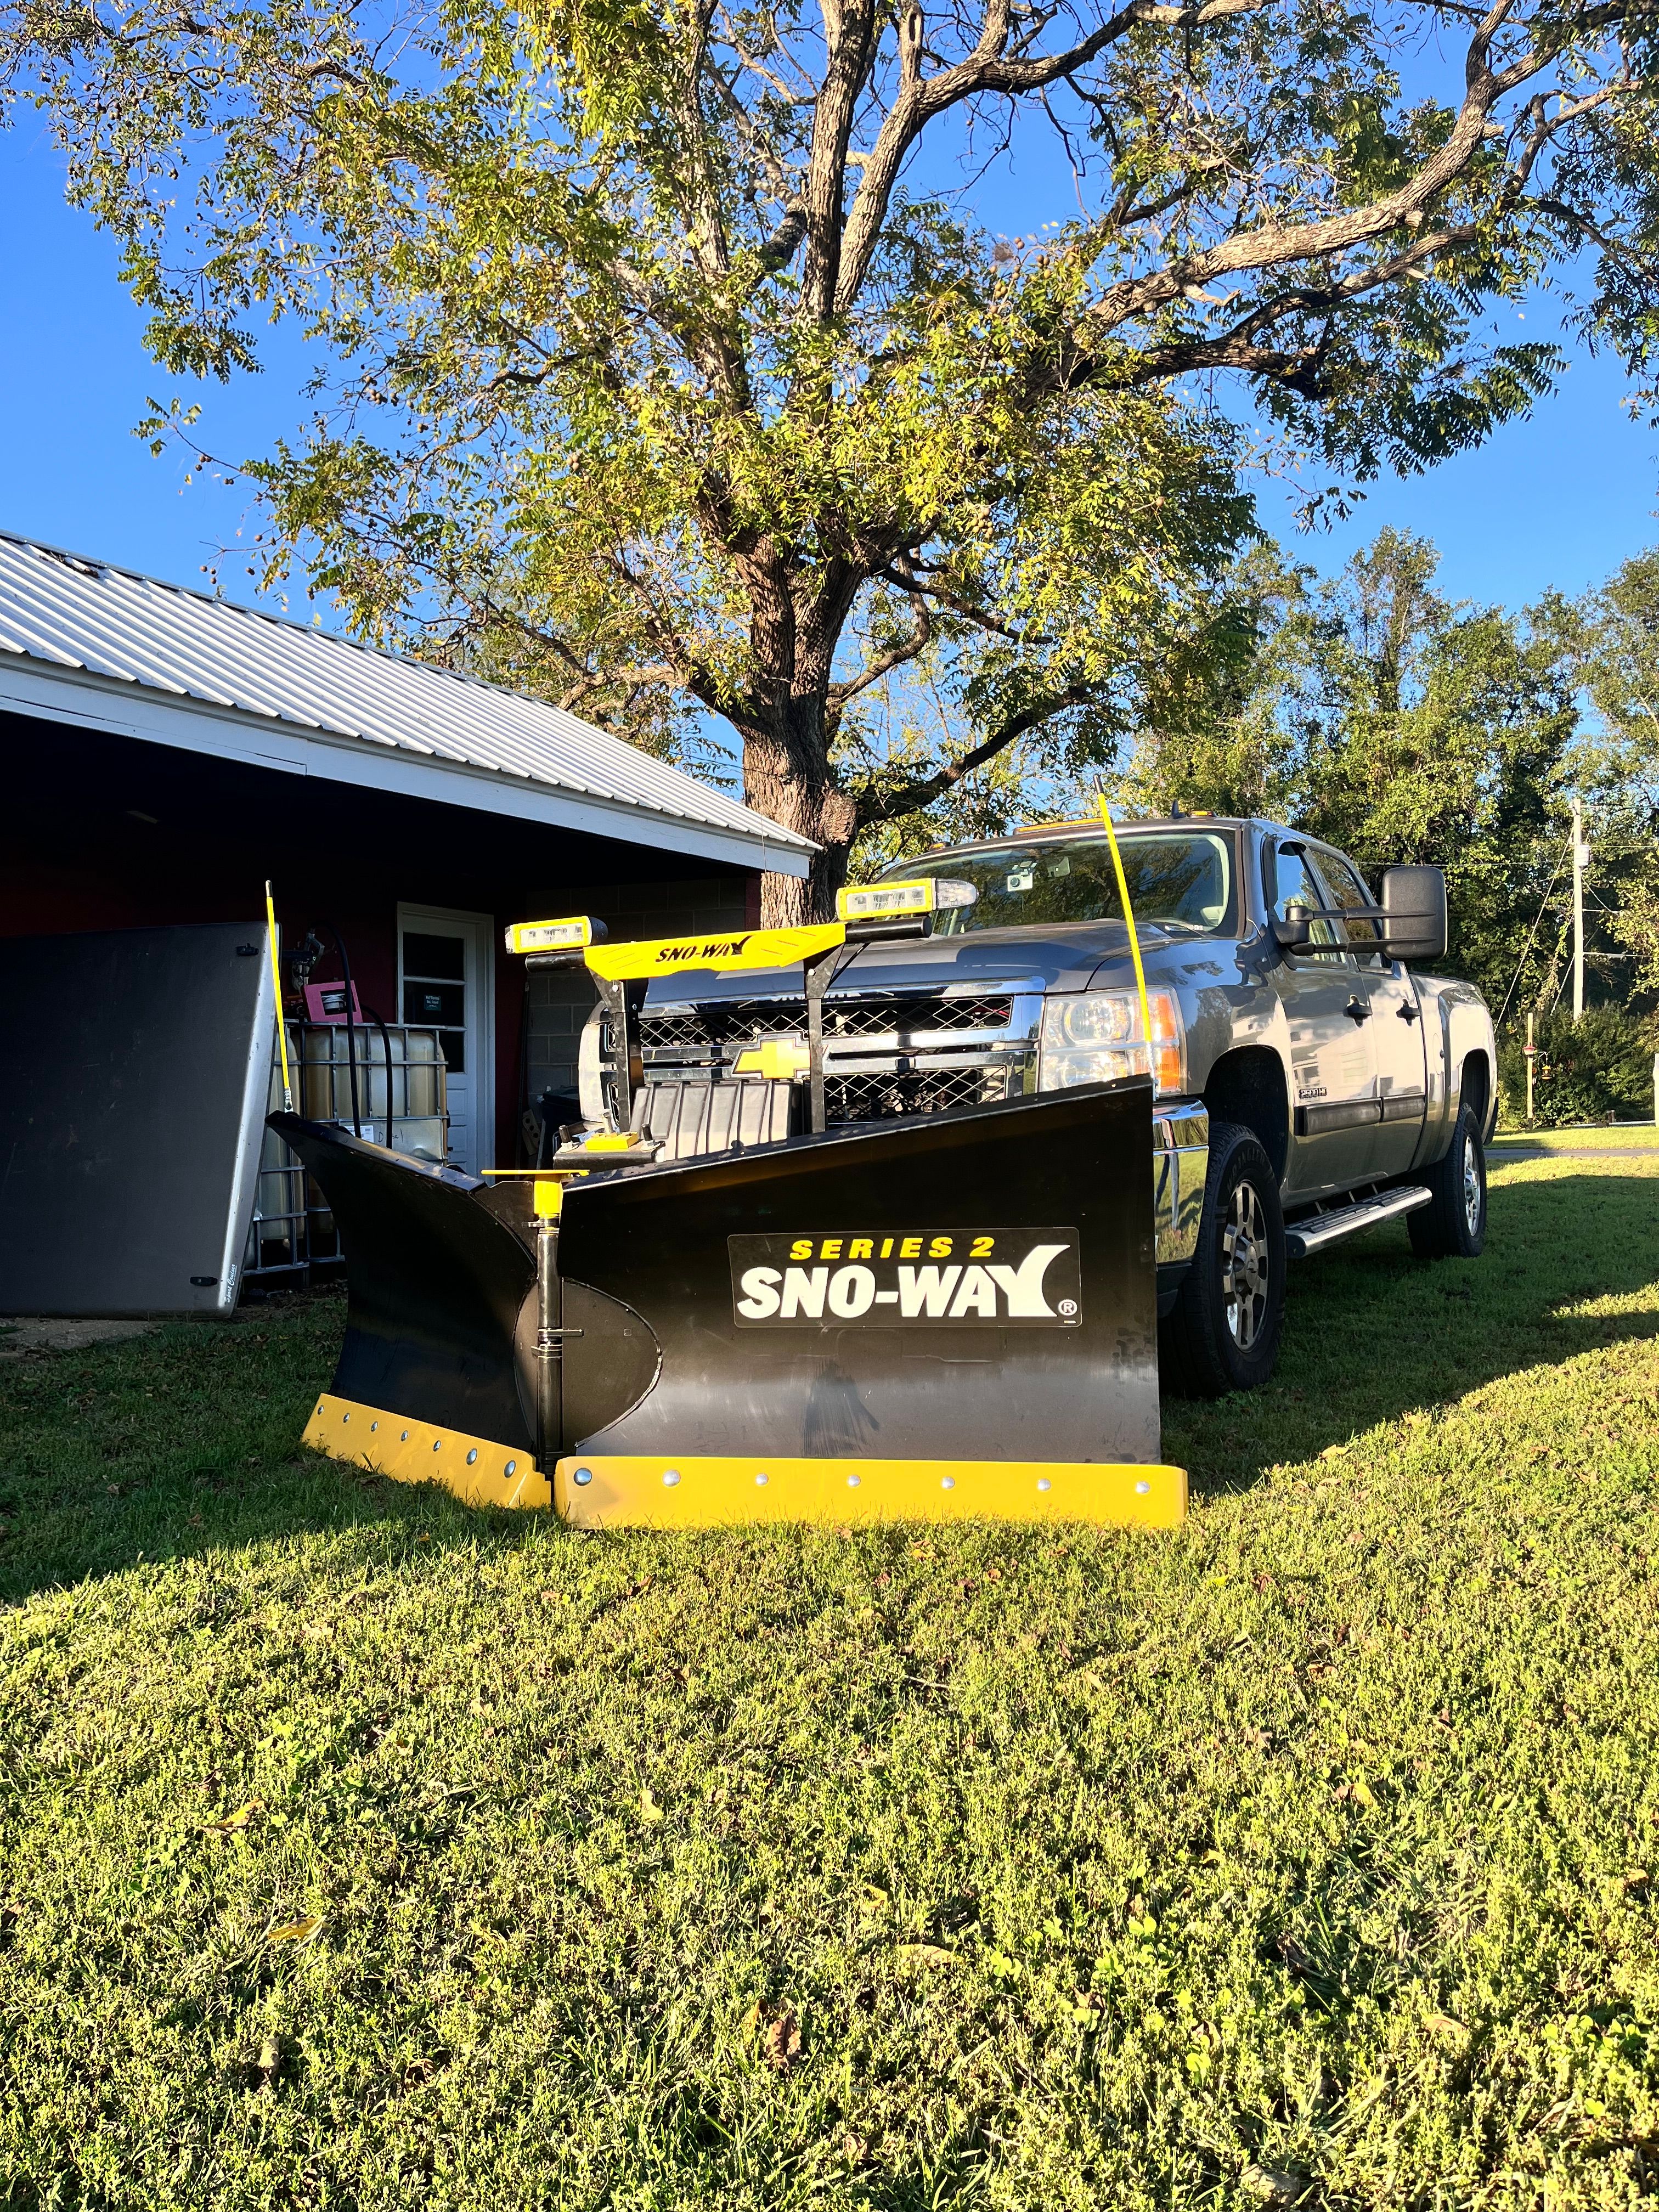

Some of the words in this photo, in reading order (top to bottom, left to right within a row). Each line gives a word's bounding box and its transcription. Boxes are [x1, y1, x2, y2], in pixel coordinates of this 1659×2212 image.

[655, 935, 753, 962] SNO-WAY
[789, 1237, 953, 1260] SERIES
[969, 1237, 995, 1257] 2
[737, 1244, 1071, 1319] SNO-WAY
